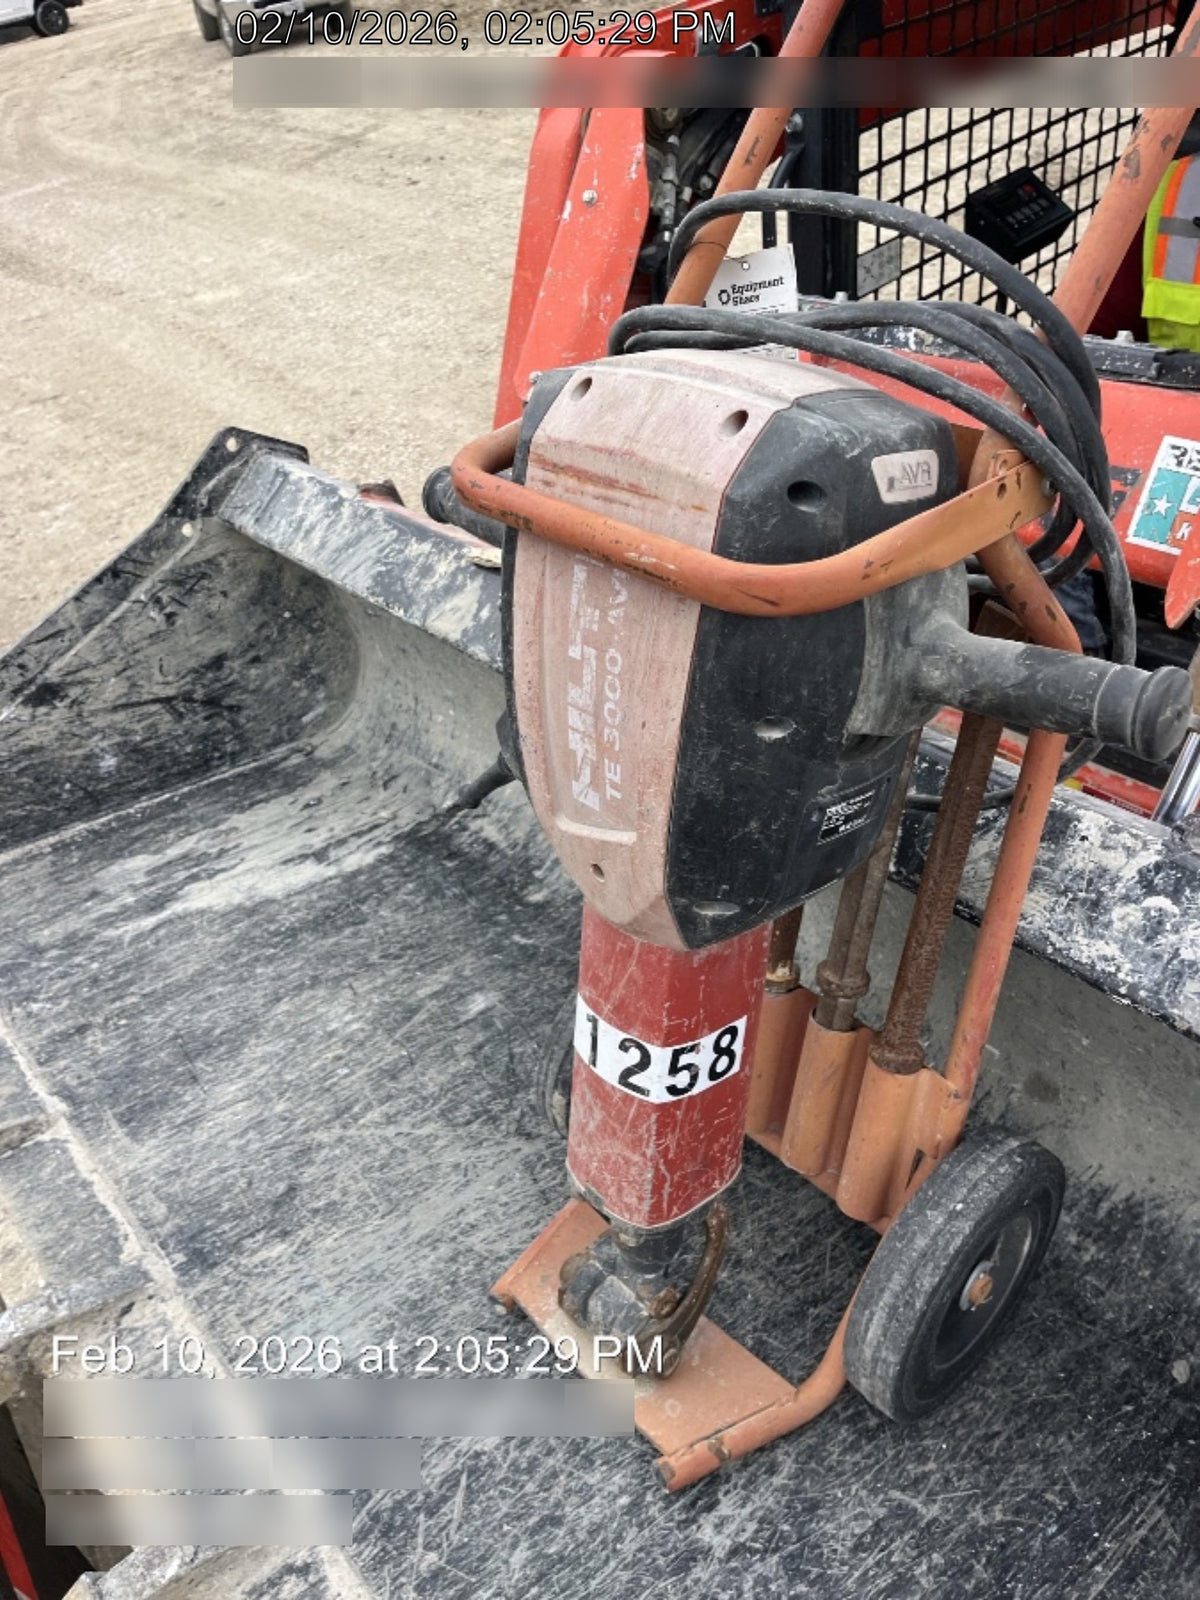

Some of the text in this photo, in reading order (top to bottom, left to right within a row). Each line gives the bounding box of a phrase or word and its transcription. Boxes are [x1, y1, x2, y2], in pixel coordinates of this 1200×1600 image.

[731, 276, 784, 295] Equipment
[603, 648, 623, 751] 3000
[604, 758, 623, 800] TE
[586, 1013, 738, 1097] 1258
